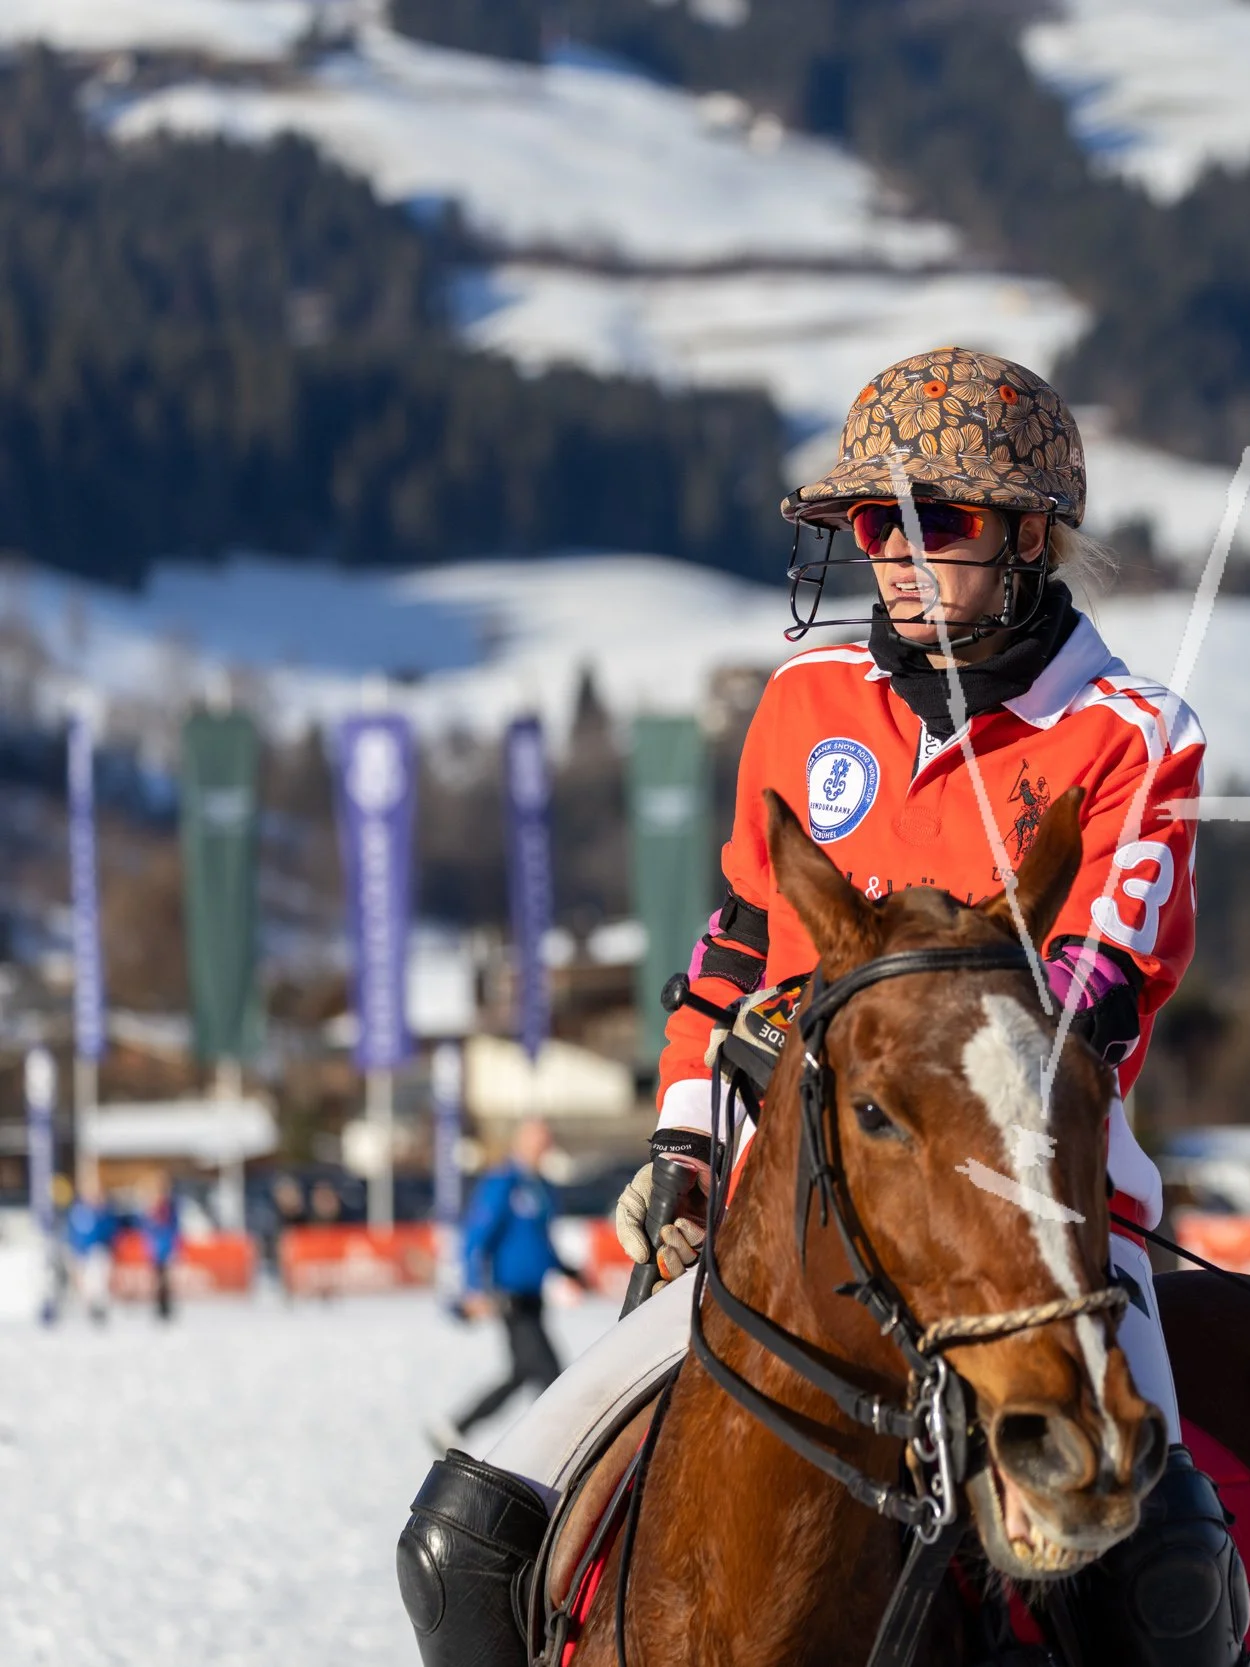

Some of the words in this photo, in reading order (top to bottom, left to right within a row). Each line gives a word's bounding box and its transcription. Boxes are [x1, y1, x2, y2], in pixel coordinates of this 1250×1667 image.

[813, 743, 832, 758] BANK
[834, 742, 857, 752] SNOW
[856, 748, 871, 763] POLO
[868, 763, 876, 785] WORLD
[865, 787, 875, 803] CUP
[833, 804, 851, 815] BANK
[865, 876, 882, 900] &
[1091, 841, 1174, 955] 3
